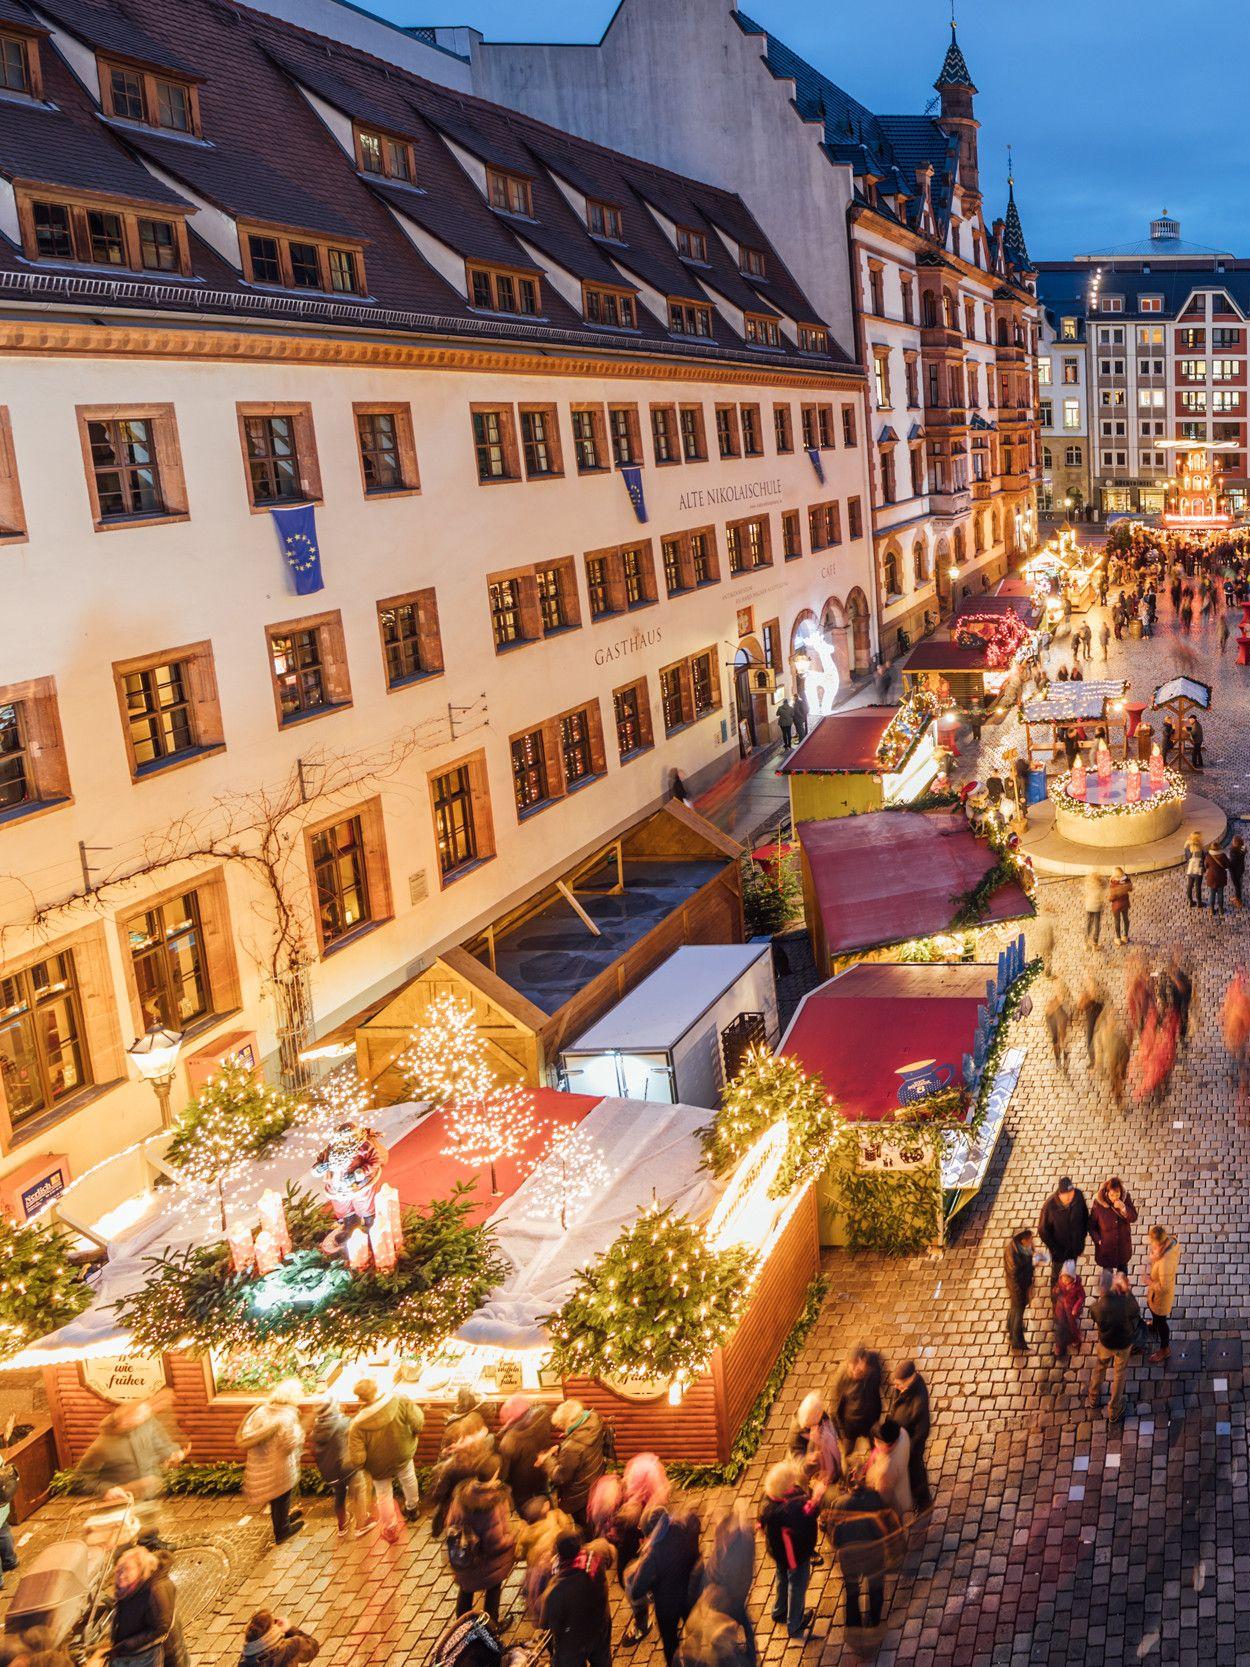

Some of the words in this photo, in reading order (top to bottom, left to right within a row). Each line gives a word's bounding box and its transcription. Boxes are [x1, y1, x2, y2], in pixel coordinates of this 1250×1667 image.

[679, 491, 704, 510] ALTE
[707, 479, 782, 505] NIKOLAISCHULE
[594, 627, 662, 666] GASTHAUS
[114, 1362, 134, 1373] wie
[108, 1374, 146, 1390] früher
